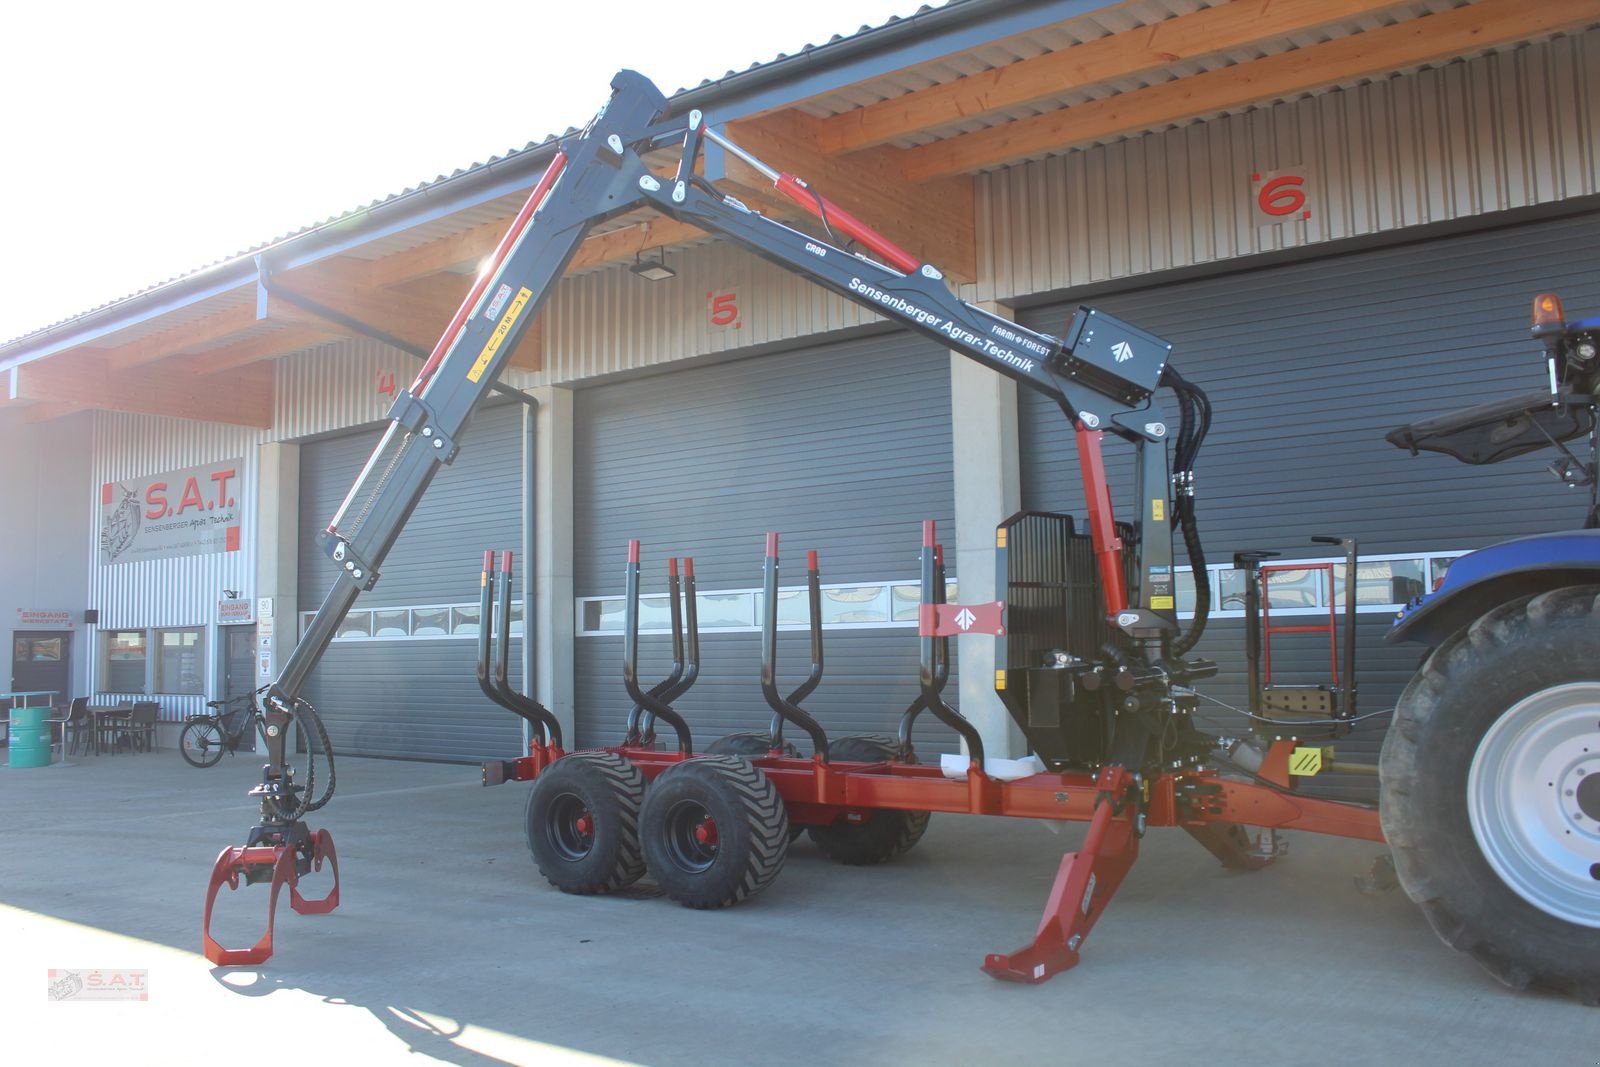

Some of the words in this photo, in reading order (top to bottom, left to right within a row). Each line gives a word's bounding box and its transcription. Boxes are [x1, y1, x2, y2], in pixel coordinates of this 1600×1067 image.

[1258, 175, 1305, 216] 6
[712, 293, 738, 325] 5
[848, 277, 942, 327] Sensenberger
[940, 320, 1035, 373] Agrar-Technik
[991, 325, 1016, 341] FARMI
[1021, 338, 1051, 357] FOREST
[378, 371, 396, 396] 4
[145, 468, 236, 519] S.A.T.
[144, 521, 189, 533] SENSENBERGER
[221, 603, 249, 612] EINGANG
